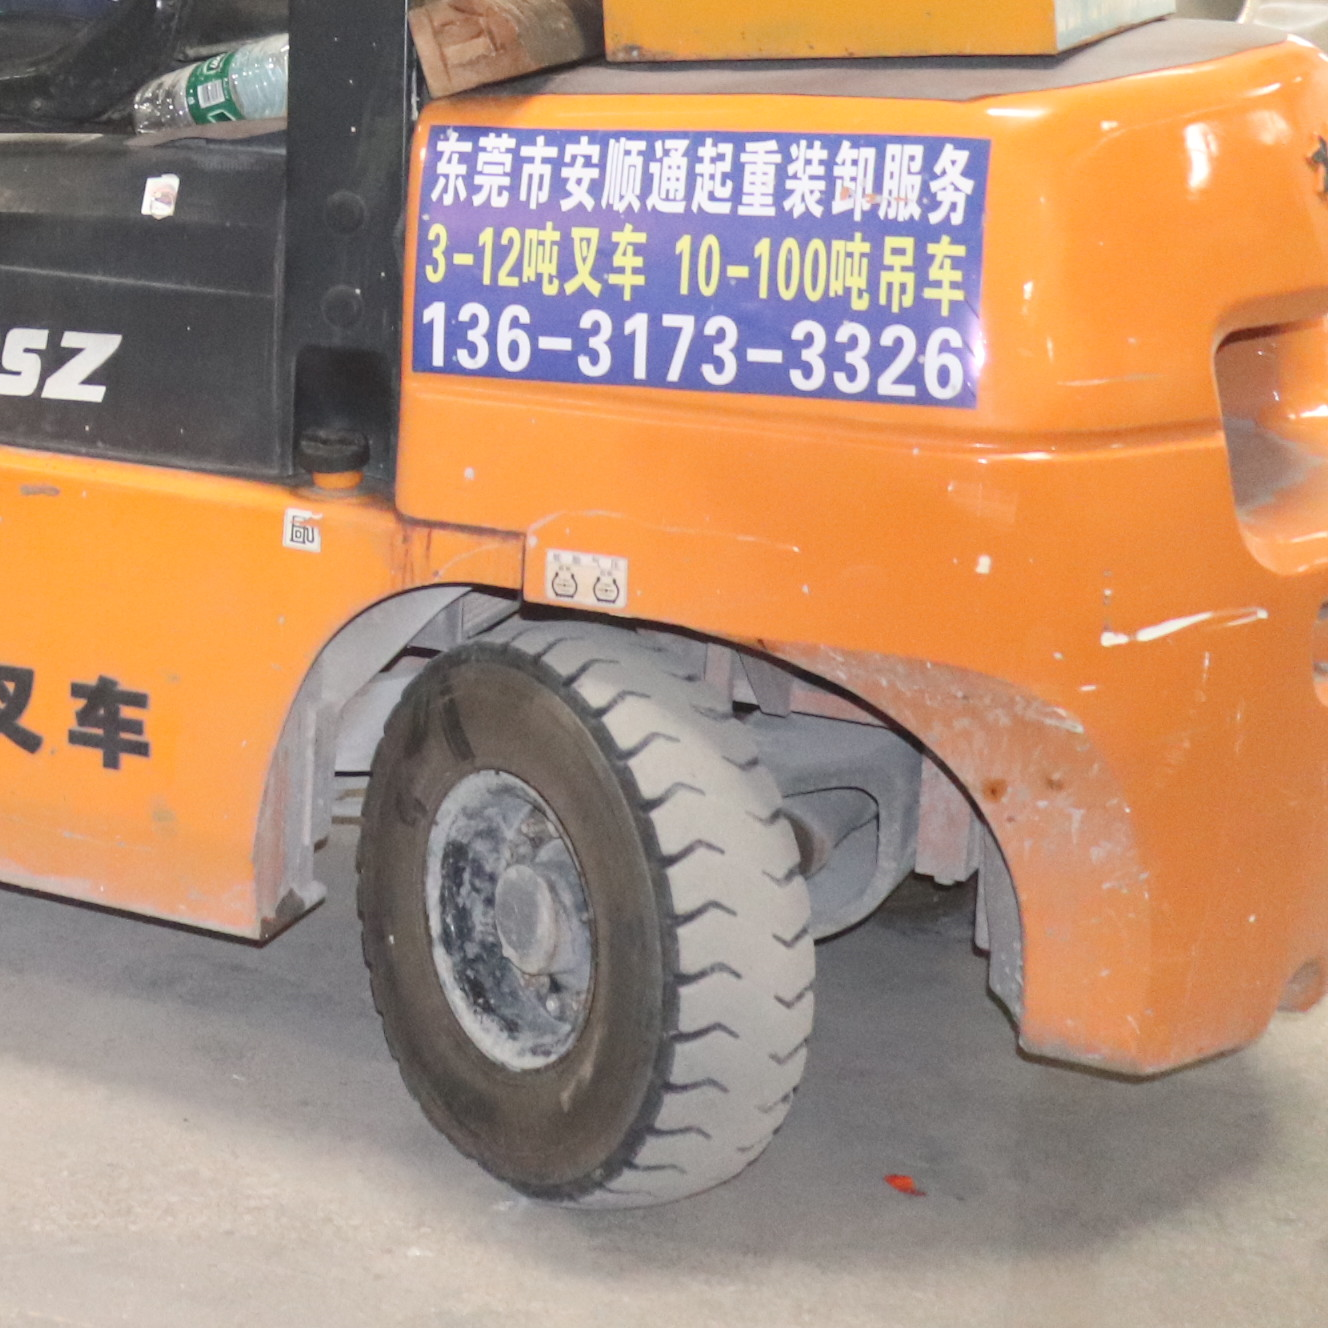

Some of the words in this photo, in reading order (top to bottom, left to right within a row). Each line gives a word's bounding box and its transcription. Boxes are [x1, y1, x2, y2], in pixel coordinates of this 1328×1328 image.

[430, 132, 975, 225] 东莞市安顺通起重装卸服务
[425, 221, 647, 301] 3-12吨叉车
[675, 231, 967, 317] 10-100吨吊车
[422, 301, 965, 400] 136-3173-3326
